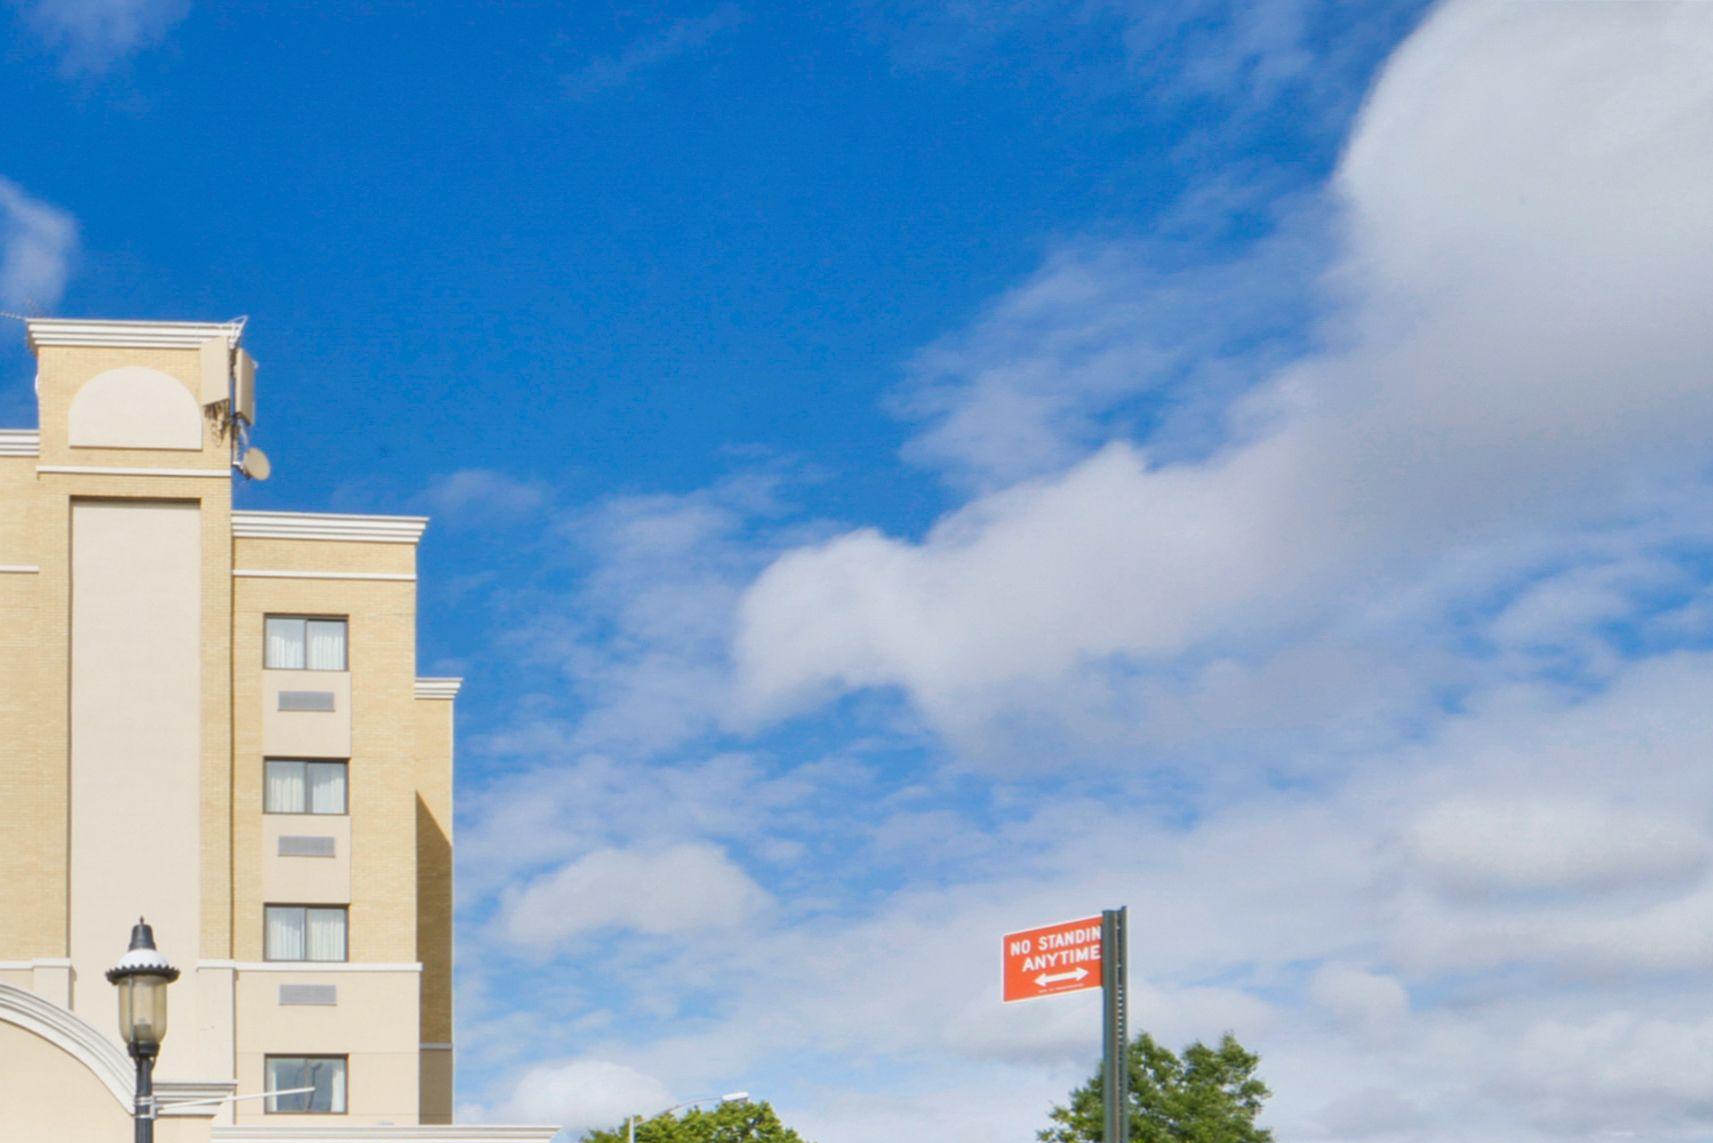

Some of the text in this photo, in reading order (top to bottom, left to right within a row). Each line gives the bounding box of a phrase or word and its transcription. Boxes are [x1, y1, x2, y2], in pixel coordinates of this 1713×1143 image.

[1010, 925, 1102, 957] NO STANDIN
[1022, 944, 1102, 973] ANYTIME
